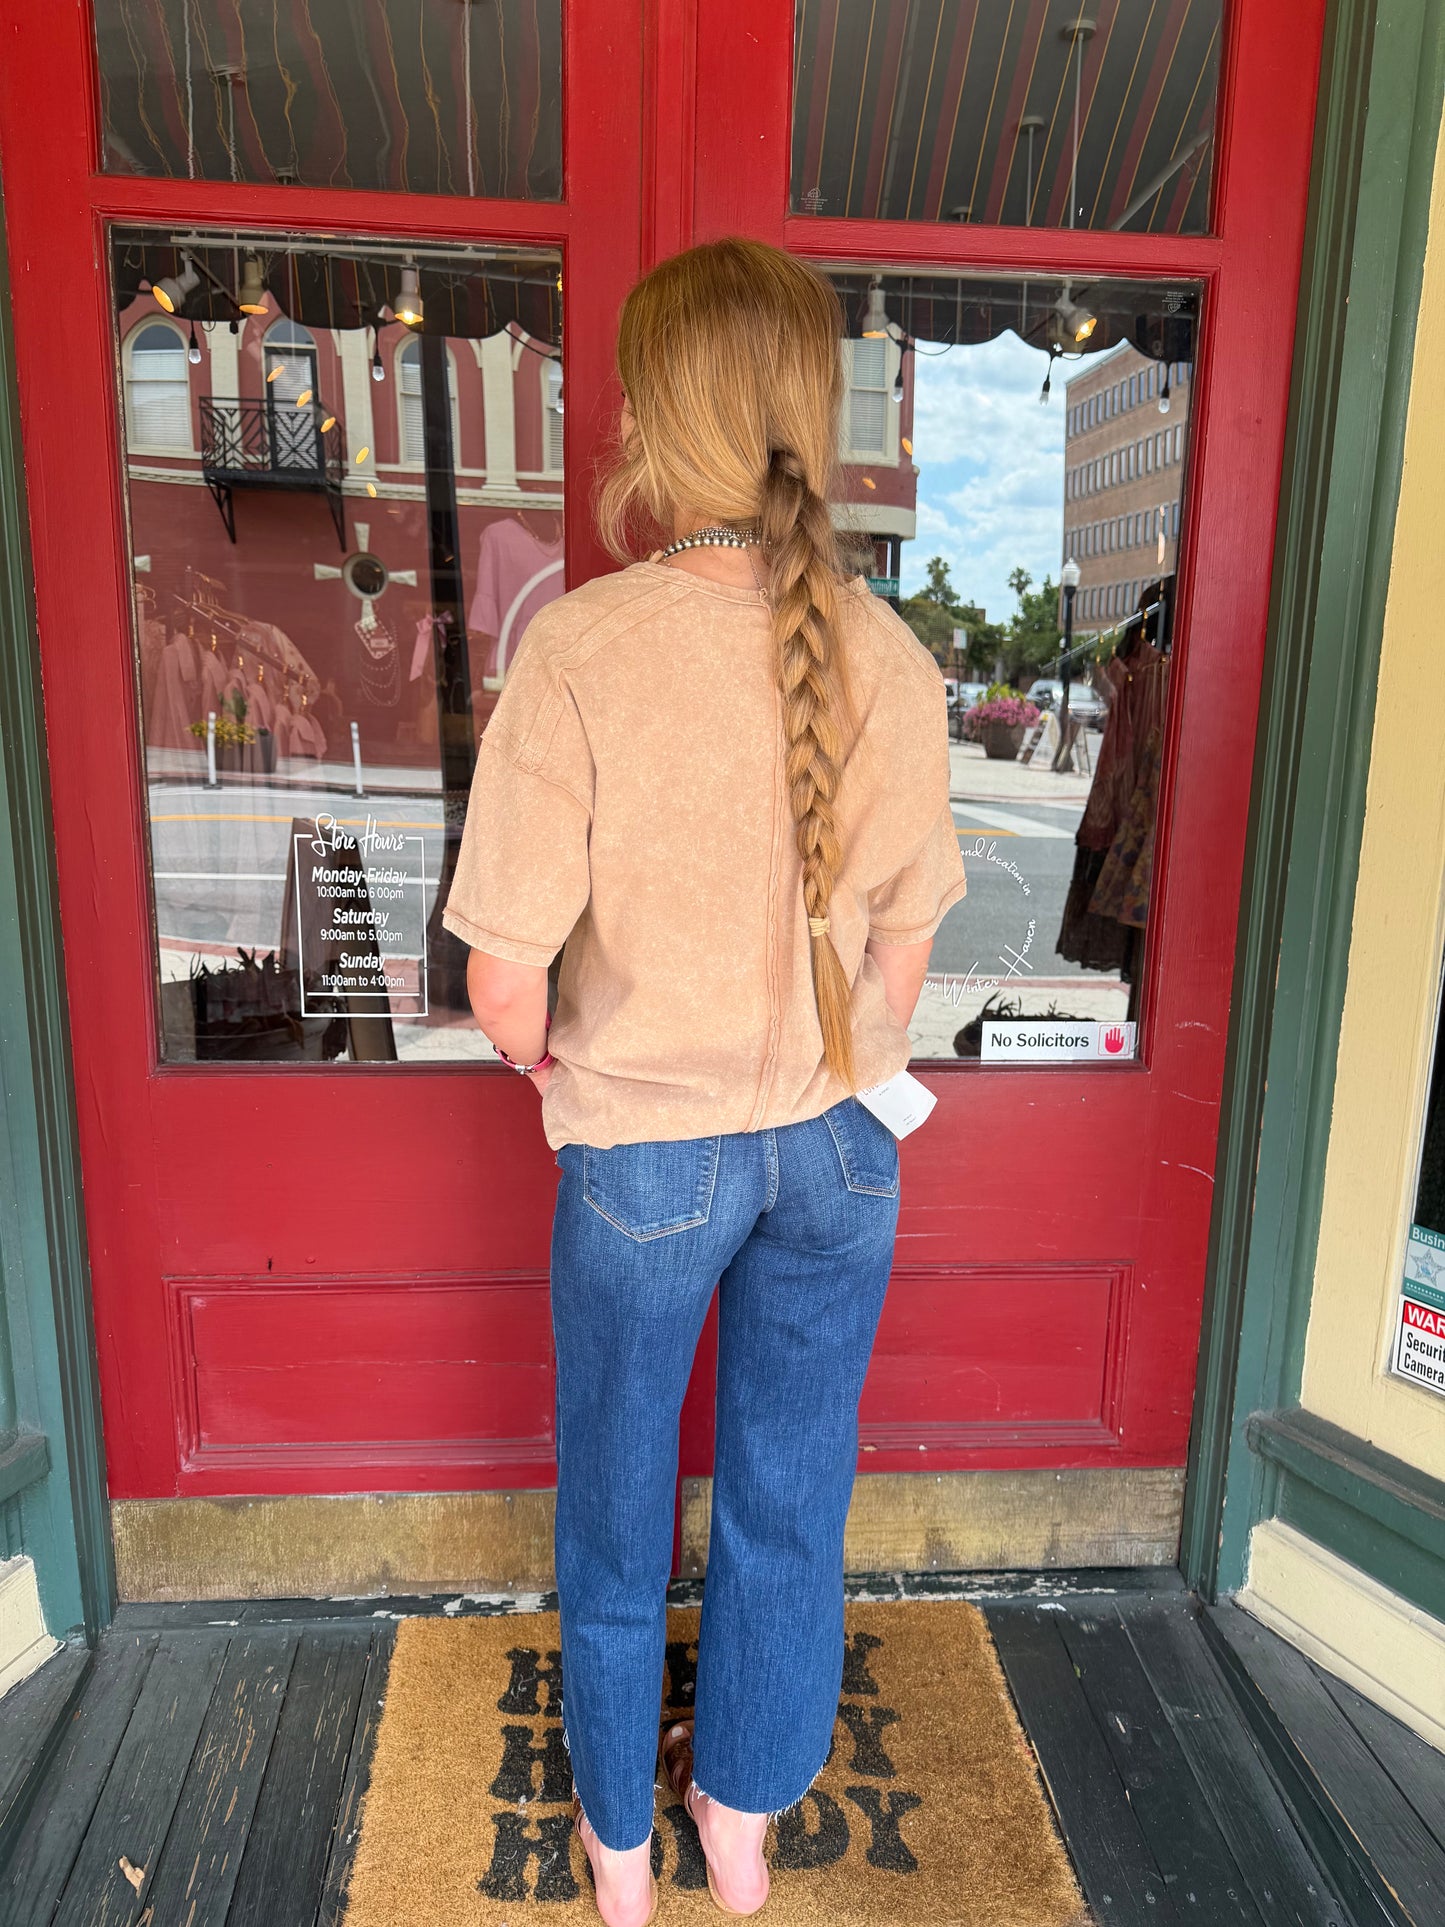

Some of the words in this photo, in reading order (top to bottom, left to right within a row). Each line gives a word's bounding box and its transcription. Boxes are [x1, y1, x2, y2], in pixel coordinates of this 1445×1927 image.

[311, 813, 356, 857] Store
[359, 813, 405, 858] Hours
[311, 866, 407, 886] Monday-Friday
[986, 841, 1024, 884] location
[1022, 883, 1031, 896] in
[317, 886, 355, 898] 10:00am
[357, 887, 367, 898] to
[368, 887, 404, 900] 600pm
[332, 907, 390, 927] Saturday
[320, 929, 355, 941] 9:00am
[357, 929, 367, 941] to
[339, 952, 386, 971] Sunday
[943, 961, 999, 1007] Winter
[999, 919, 1036, 981] Haven
[321, 974, 356, 986] 11:00am
[358, 975, 368, 987] to
[991, 1033, 1012, 1047] No
[1016, 1033, 1090, 1047] Solicitors
